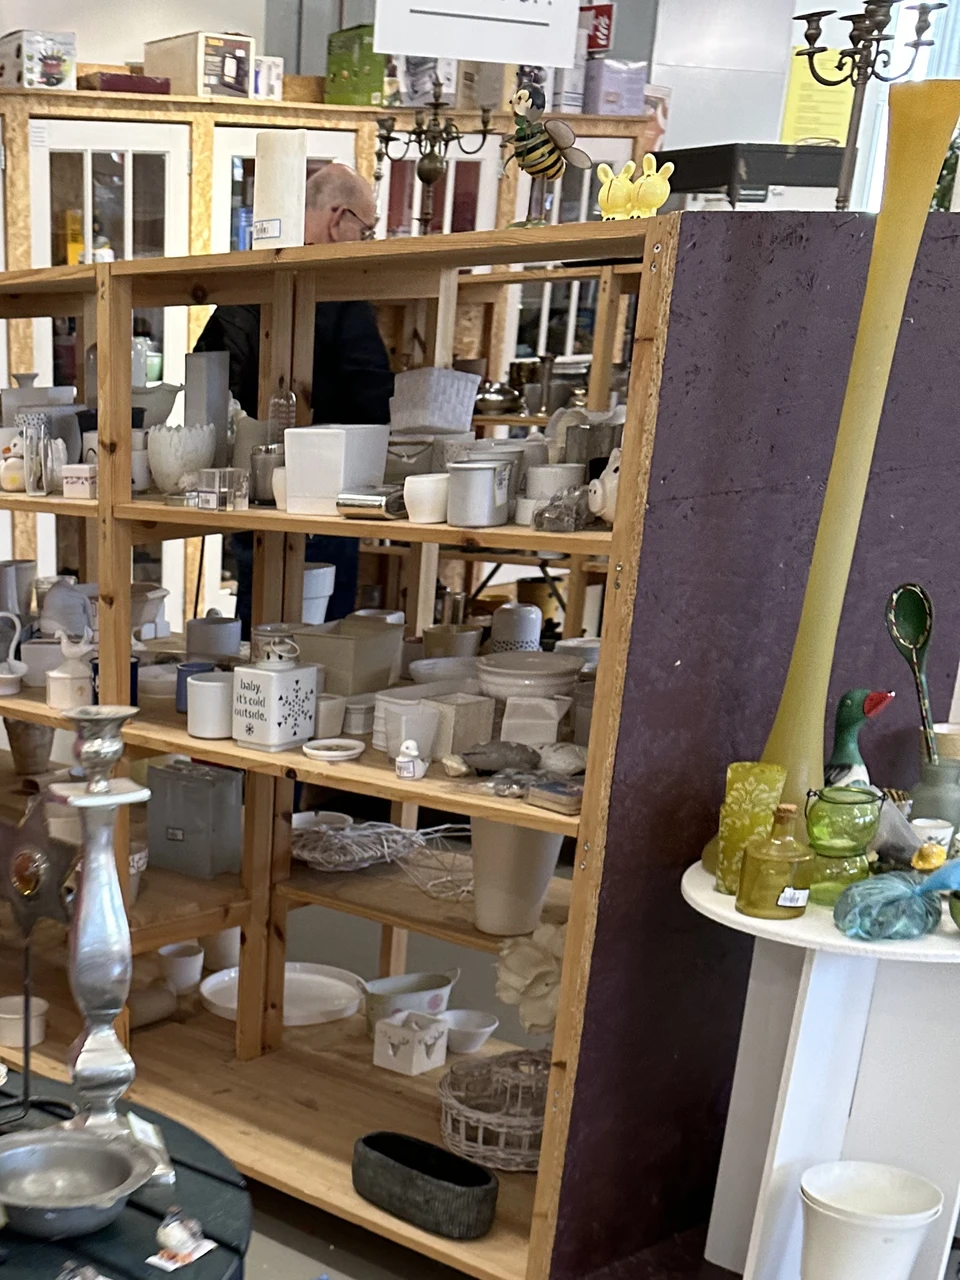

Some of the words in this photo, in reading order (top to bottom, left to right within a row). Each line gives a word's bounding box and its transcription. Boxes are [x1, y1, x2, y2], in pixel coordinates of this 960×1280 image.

[236, 693, 247, 705] it's
[248, 696, 266, 708] cold
[234, 708, 267, 722] outside.
